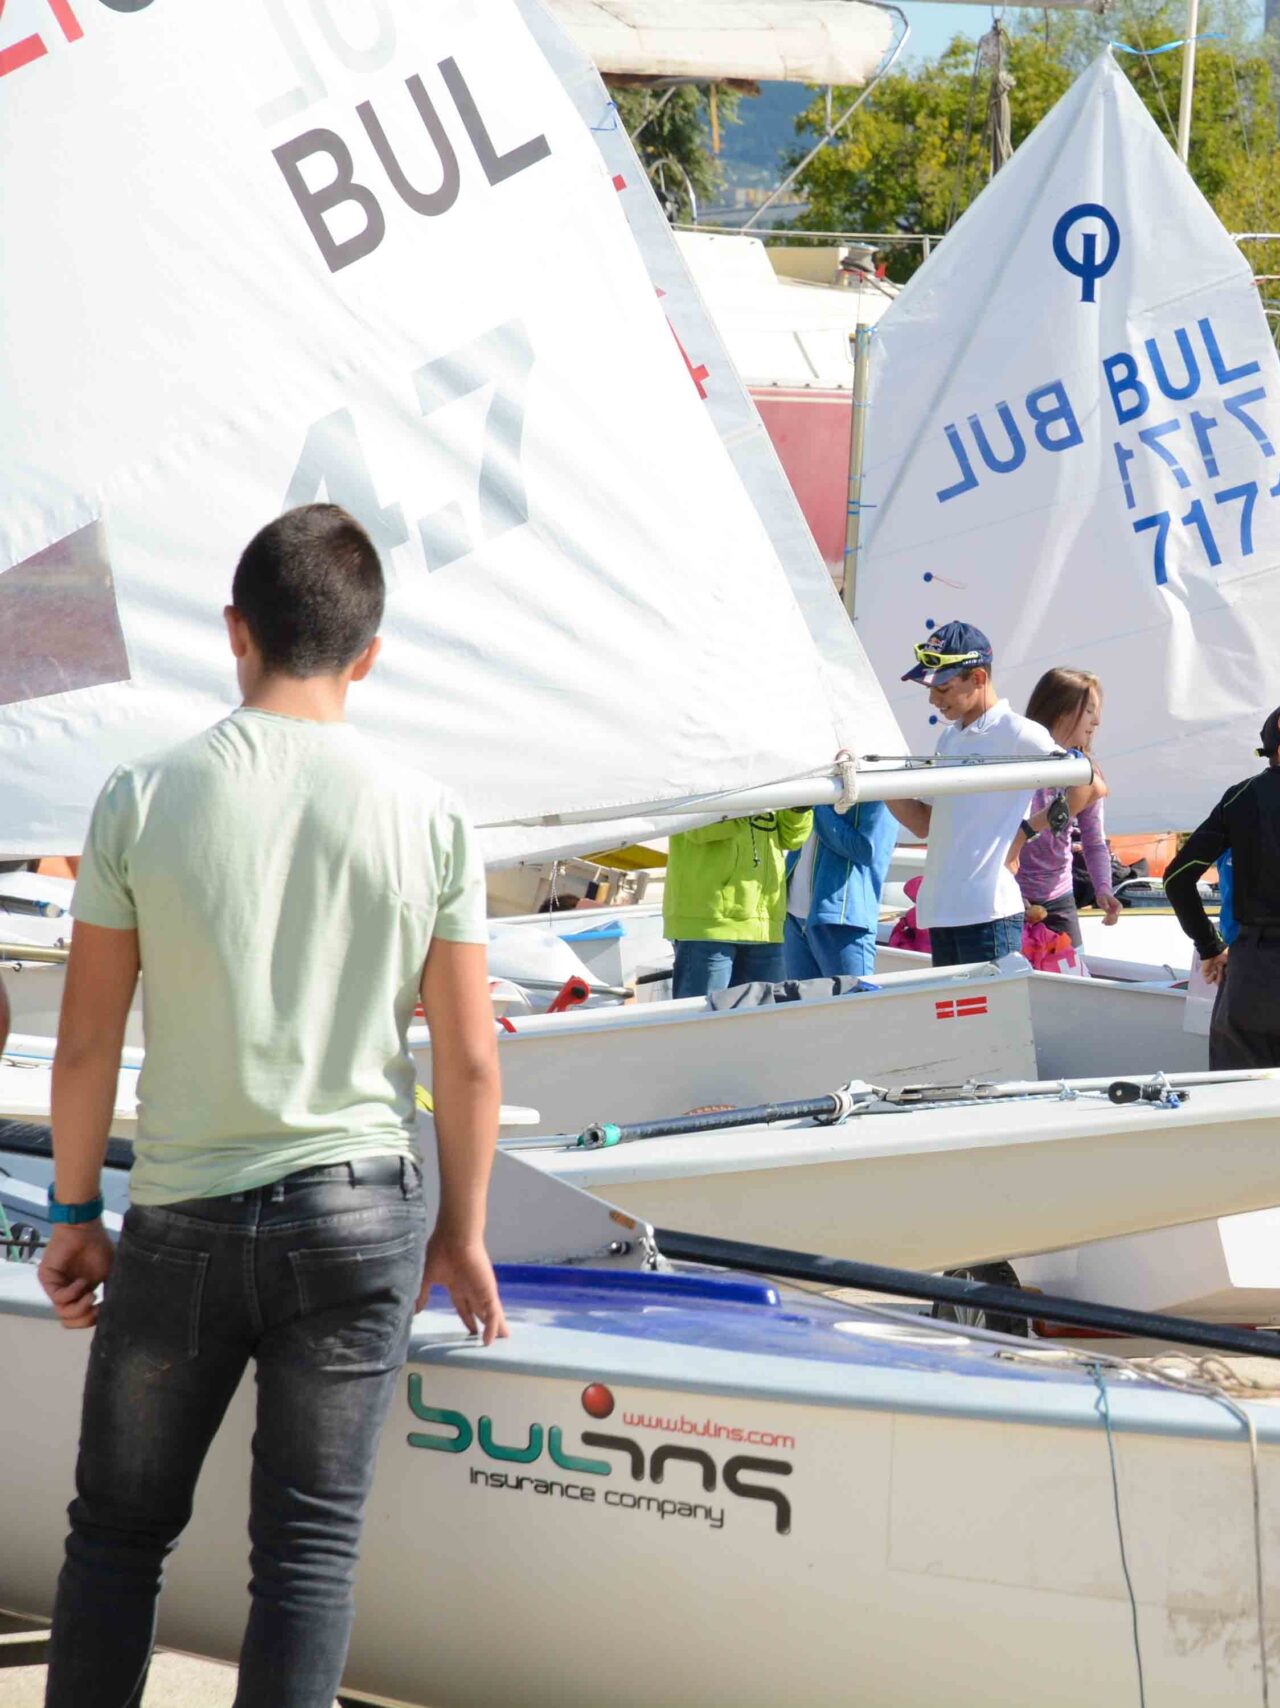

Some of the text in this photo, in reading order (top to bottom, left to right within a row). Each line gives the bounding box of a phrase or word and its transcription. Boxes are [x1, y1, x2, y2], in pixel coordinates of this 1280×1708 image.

[272, 56, 552, 273] BUL
[1102, 318, 1262, 425] BUL
[622, 1409, 796, 1450] www.bulins.com
[469, 1466, 725, 1529] Insurance company
